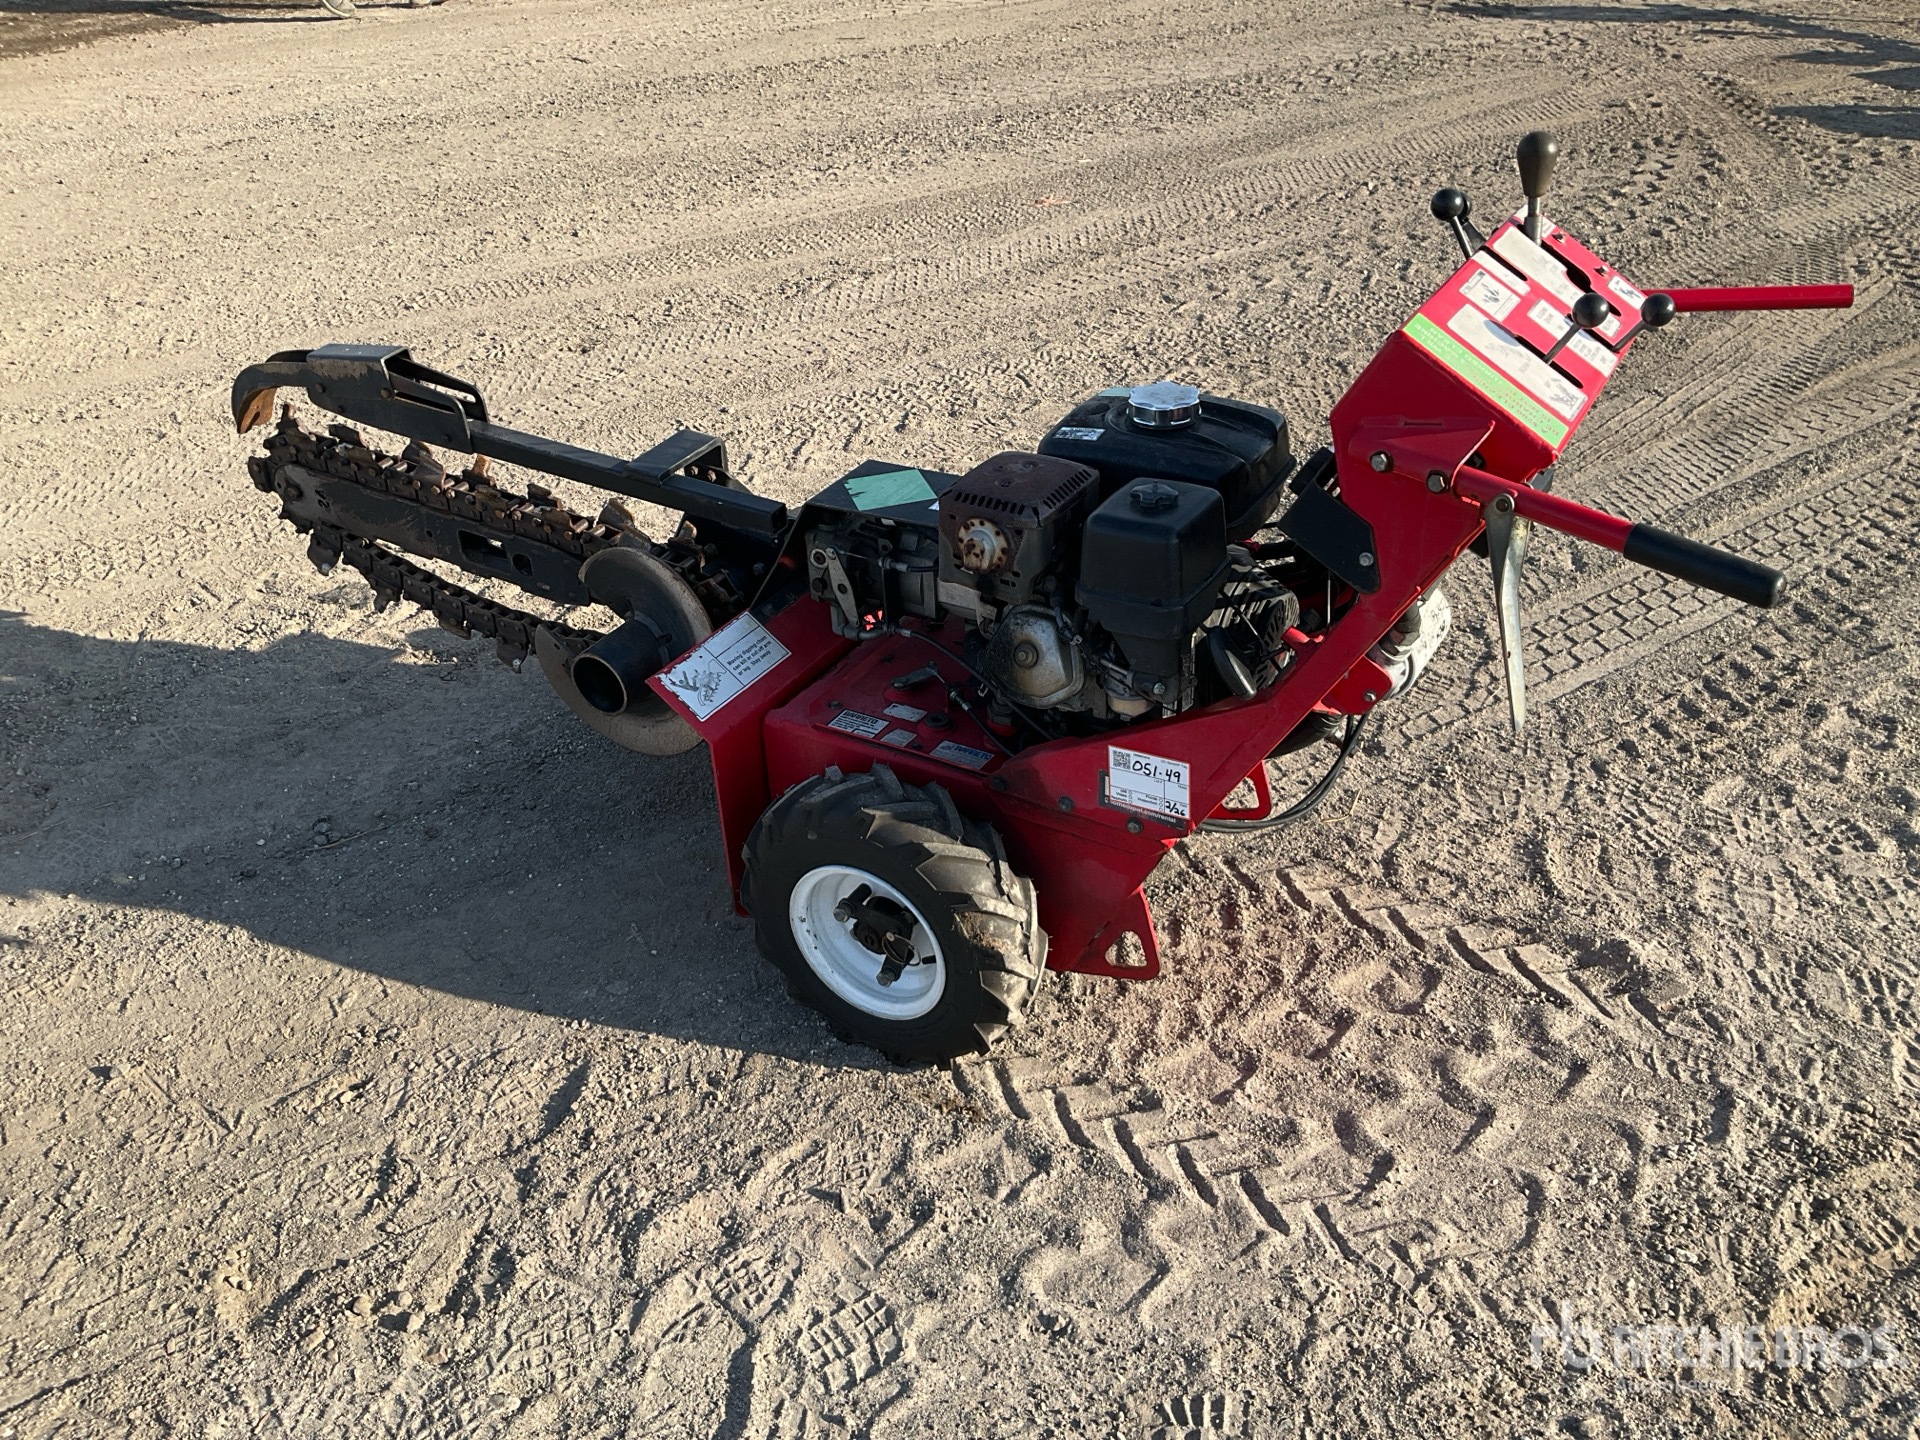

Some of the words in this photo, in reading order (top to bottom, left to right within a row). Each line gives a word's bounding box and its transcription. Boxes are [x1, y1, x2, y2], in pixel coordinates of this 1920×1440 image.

[726, 653, 743, 666] Moving
[742, 643, 758, 655] digging
[750, 657, 762, 666] Stay
